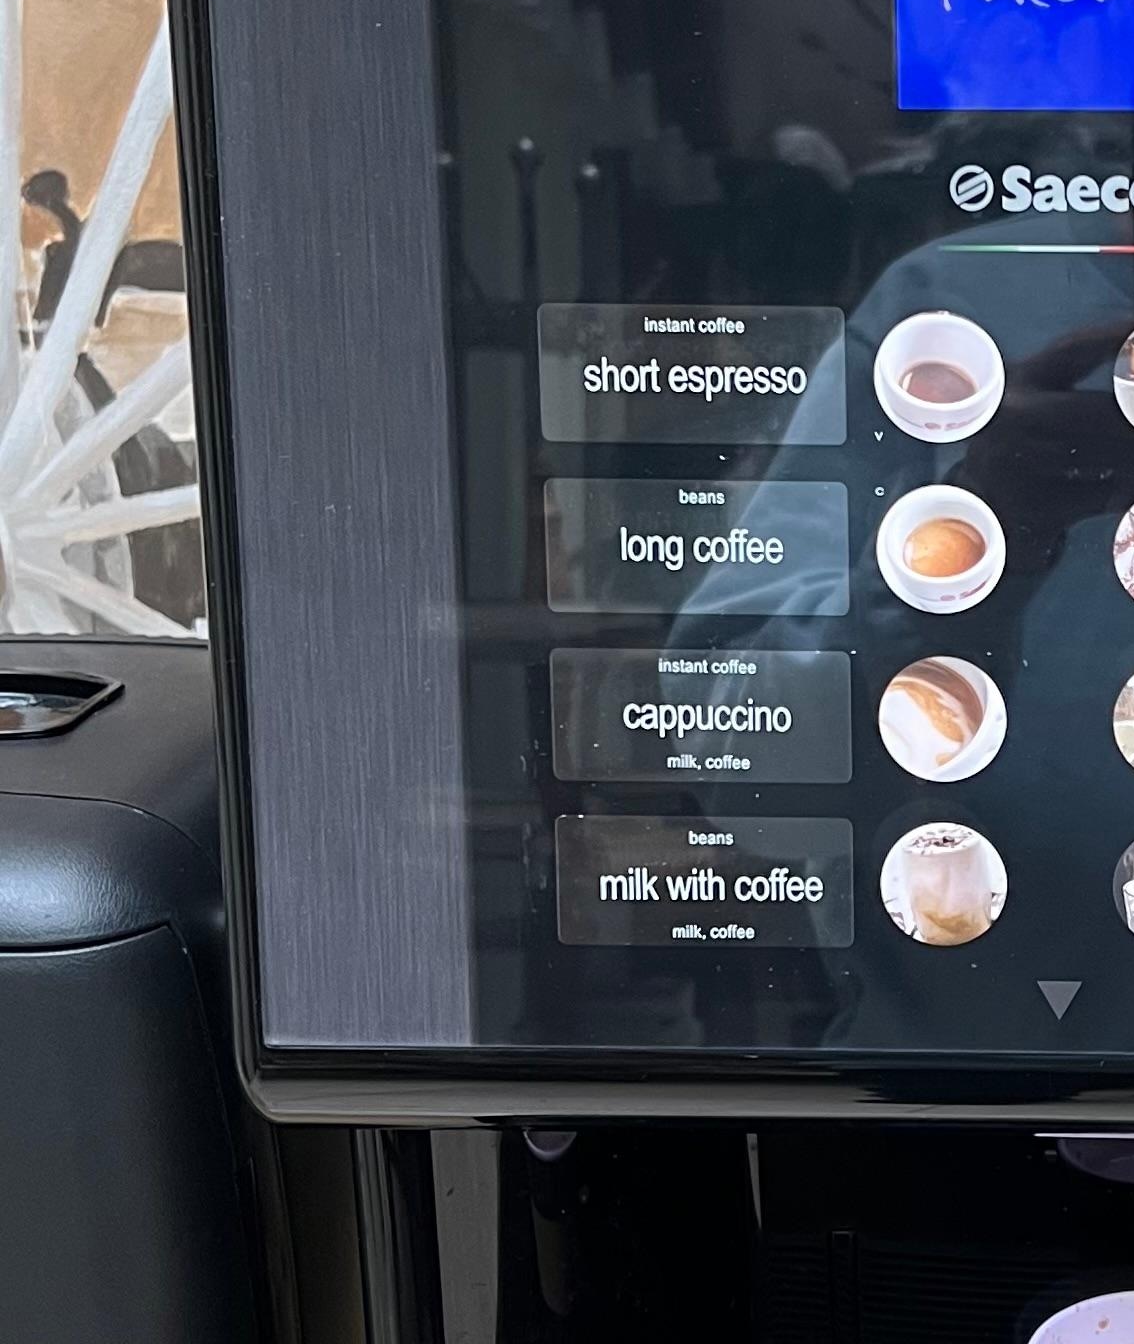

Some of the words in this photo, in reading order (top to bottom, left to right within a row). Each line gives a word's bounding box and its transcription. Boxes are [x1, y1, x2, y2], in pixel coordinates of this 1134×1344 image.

[644, 316, 696, 333] instant
[697, 316, 745, 334] coffee
[583, 356, 662, 393] short
[666, 364, 808, 403] espresso
[678, 488, 725, 505] beans
[620, 526, 684, 571] long
[693, 528, 784, 564] coffee
[658, 657, 709, 674] instant
[710, 658, 757, 675] coffee
[622, 697, 792, 739] cappuccino
[667, 753, 702, 771] milk,
[704, 754, 751, 770] coffee
[688, 830, 734, 846] beans
[599, 867, 660, 901] milk
[665, 867, 726, 901] with
[734, 867, 824, 902] coffee
[672, 924, 707, 940] milk,
[709, 923, 755, 940] coffee
